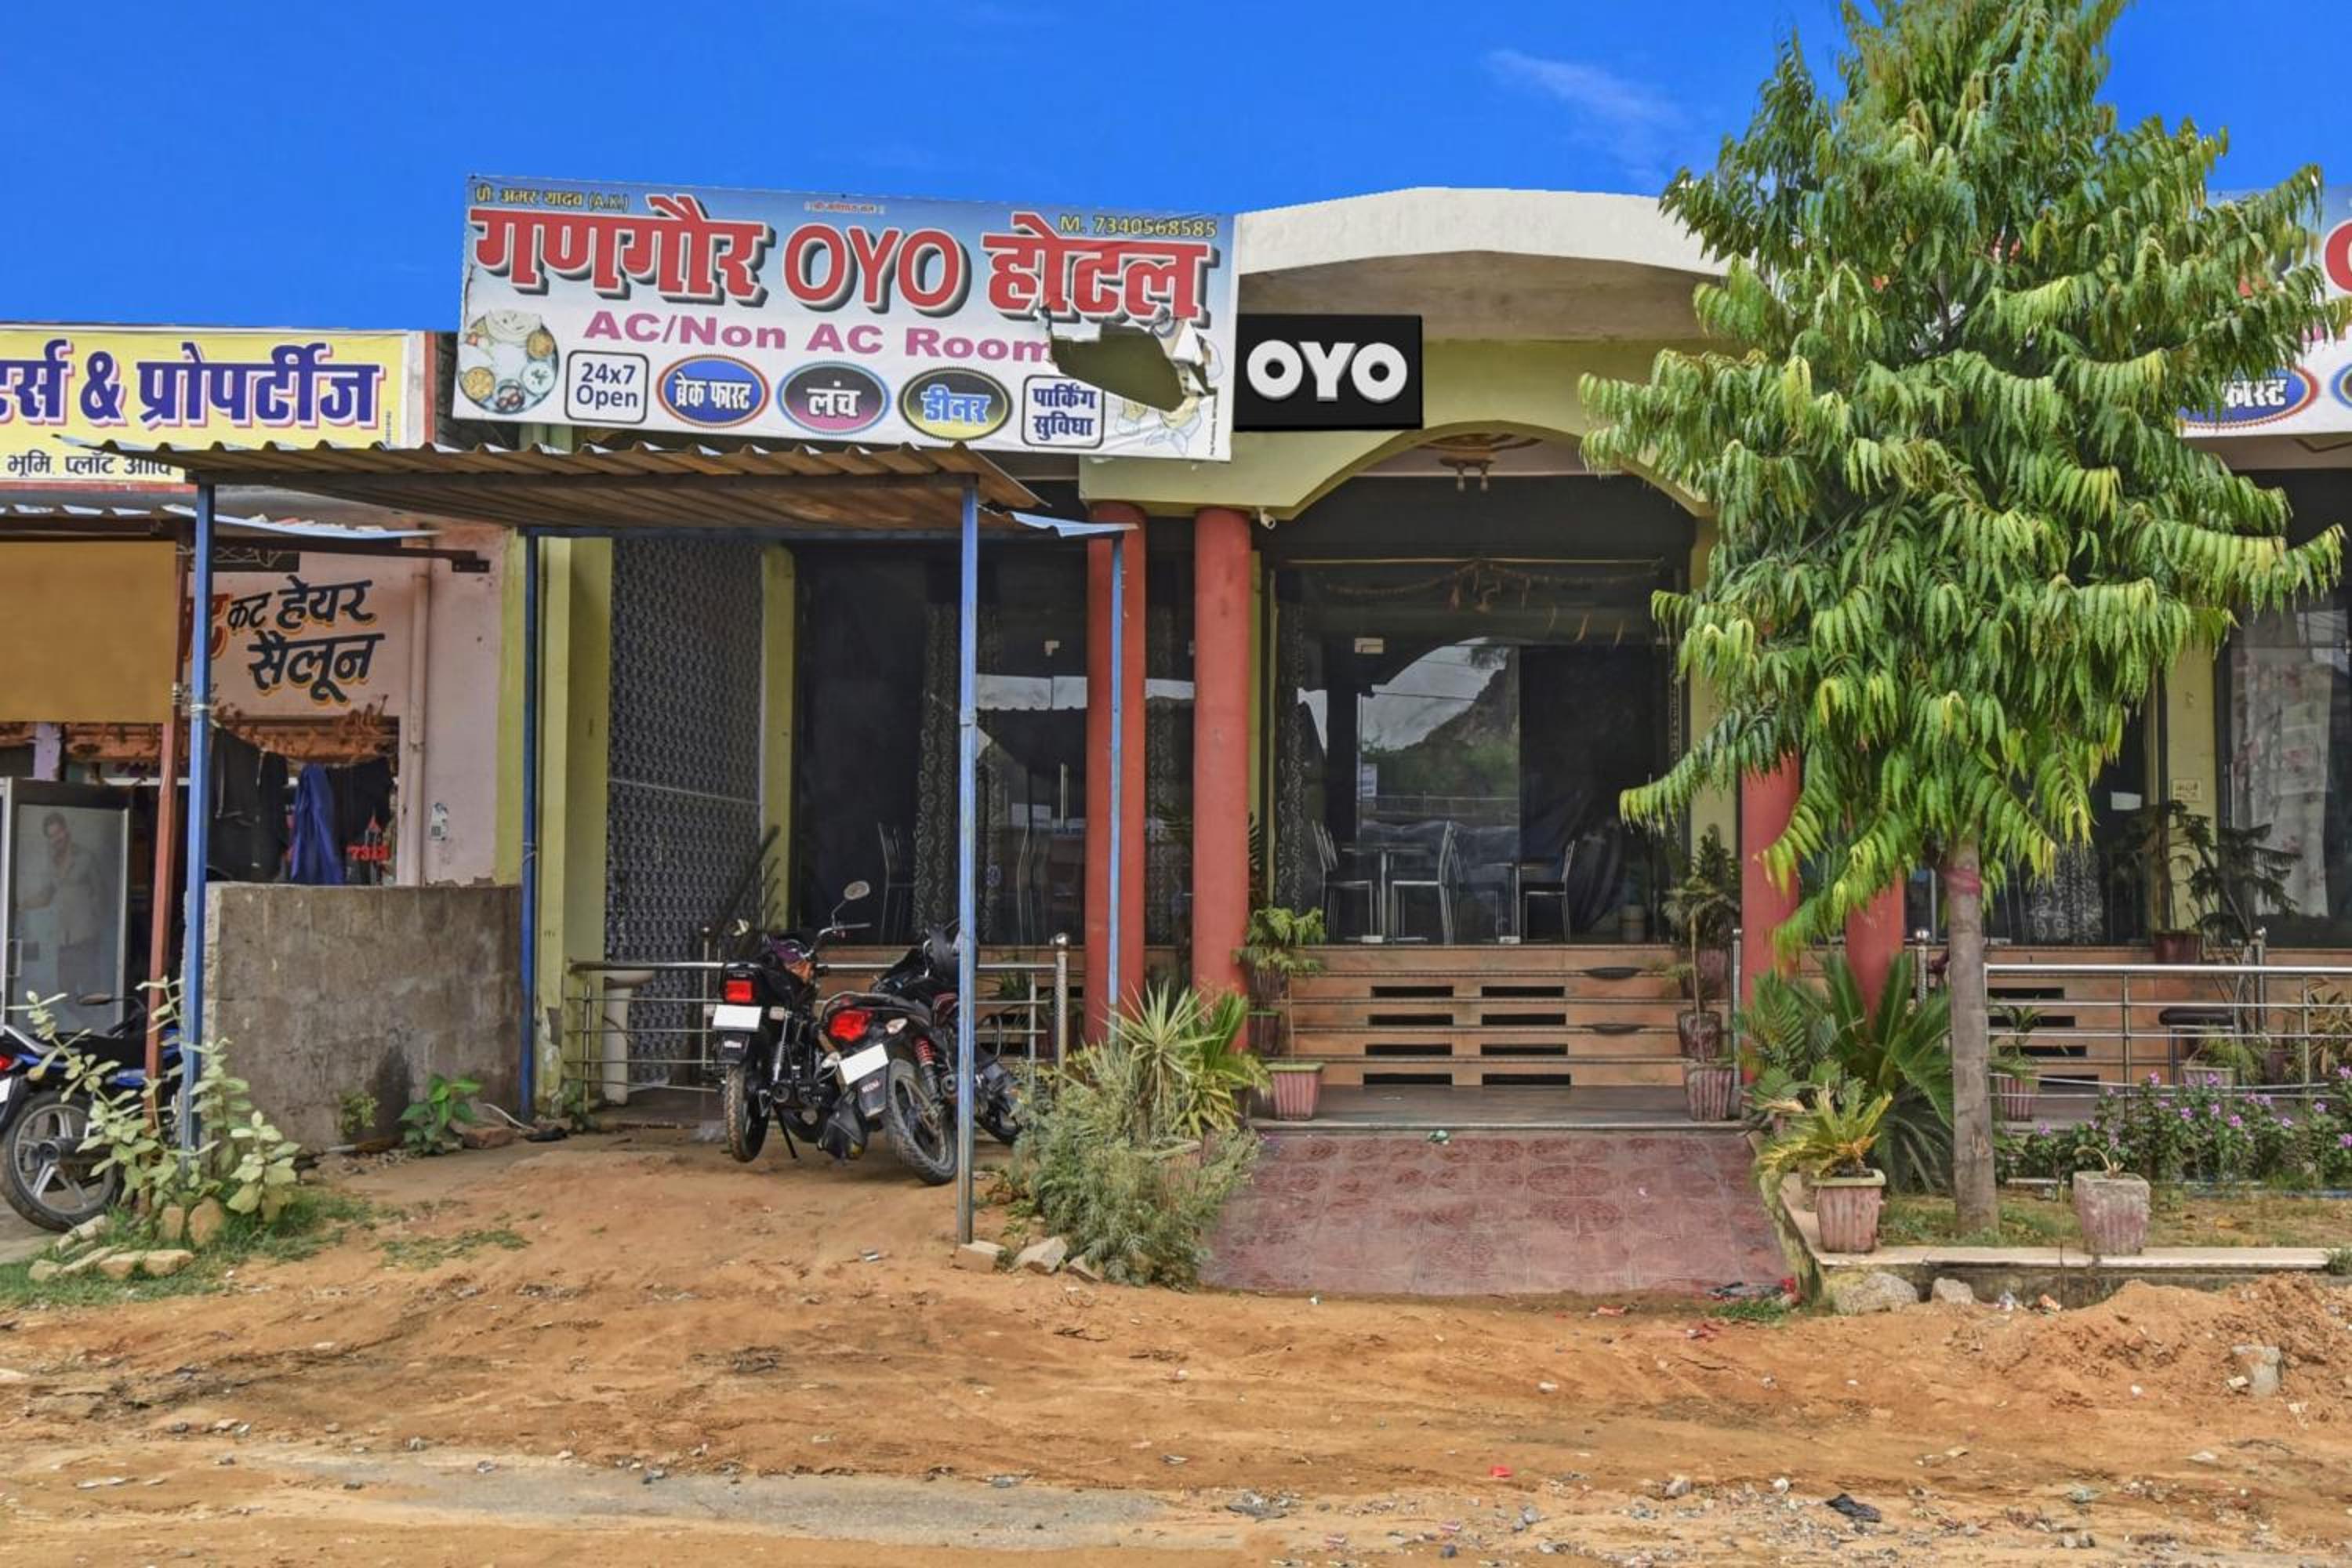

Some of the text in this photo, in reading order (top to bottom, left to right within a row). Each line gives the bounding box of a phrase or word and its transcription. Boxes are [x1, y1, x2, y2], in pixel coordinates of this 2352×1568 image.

[1094, 216, 1217, 237] 7340568585
[470, 194, 1213, 320] गणगौर OYO होटल
[584, 311, 786, 350] AC/Non
[806, 323, 884, 354] AC
[80, 350, 123, 422] &
[137, 341, 382, 425] प्रोपर्टीज
[581, 362, 636, 385] 24x7
[674, 371, 752, 409] ब्रेक फास्ट
[1247, 339, 1408, 403] OYO
[576, 386, 637, 410] Open
[806, 380, 862, 417] लंच
[920, 383, 991, 425] डीनर
[1032, 382, 1097, 408] पार्किंग
[277, 575, 373, 630] हेयर
[247, 630, 386, 703] सैलून
